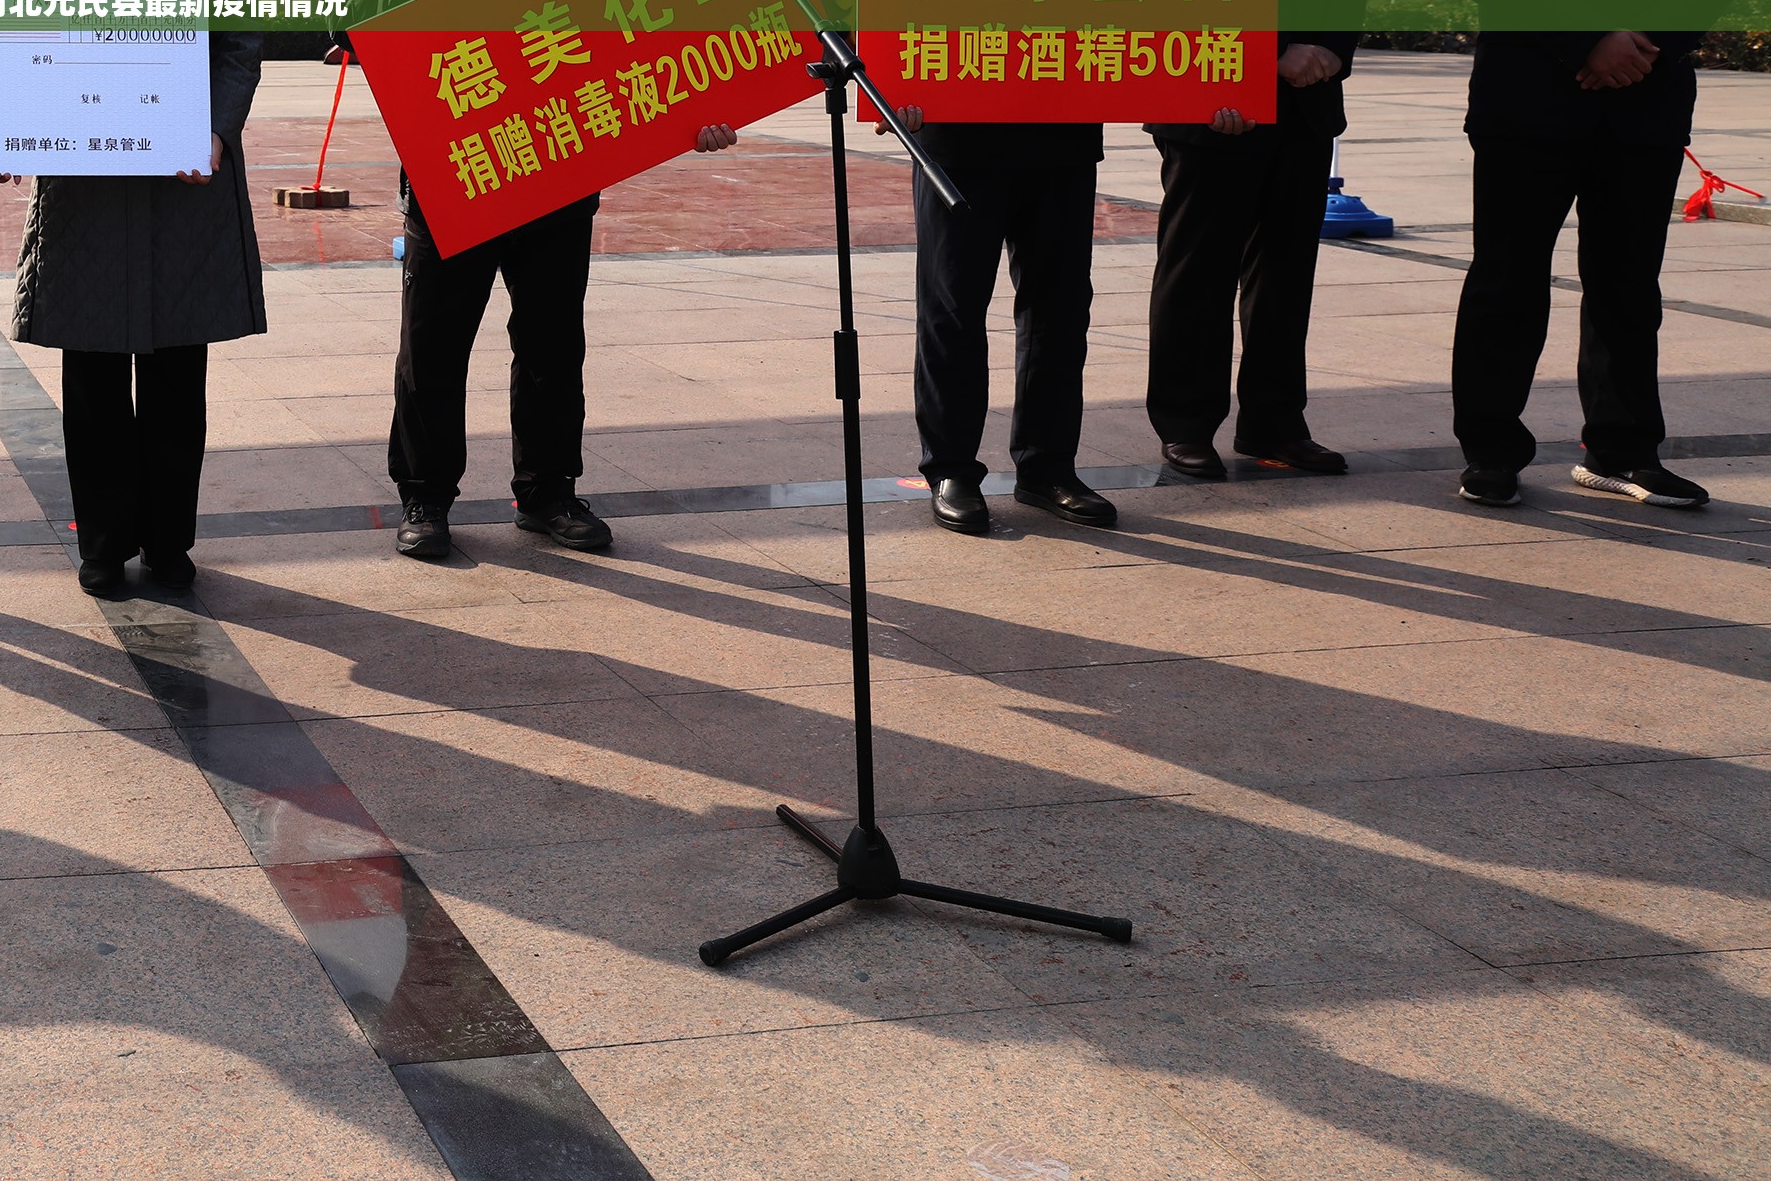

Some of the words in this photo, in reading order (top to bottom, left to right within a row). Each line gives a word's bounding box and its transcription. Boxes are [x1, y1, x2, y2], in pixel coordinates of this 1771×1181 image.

[31, 54, 53, 65] 密码
[899, 22, 1244, 83] 捐赠酒精50桶
[80, 93, 102, 104] 复核
[448, 0, 803, 200] 捐赠消毒液2000瓶
[4, 137, 152, 152] 捐赠单位：星泉管业
